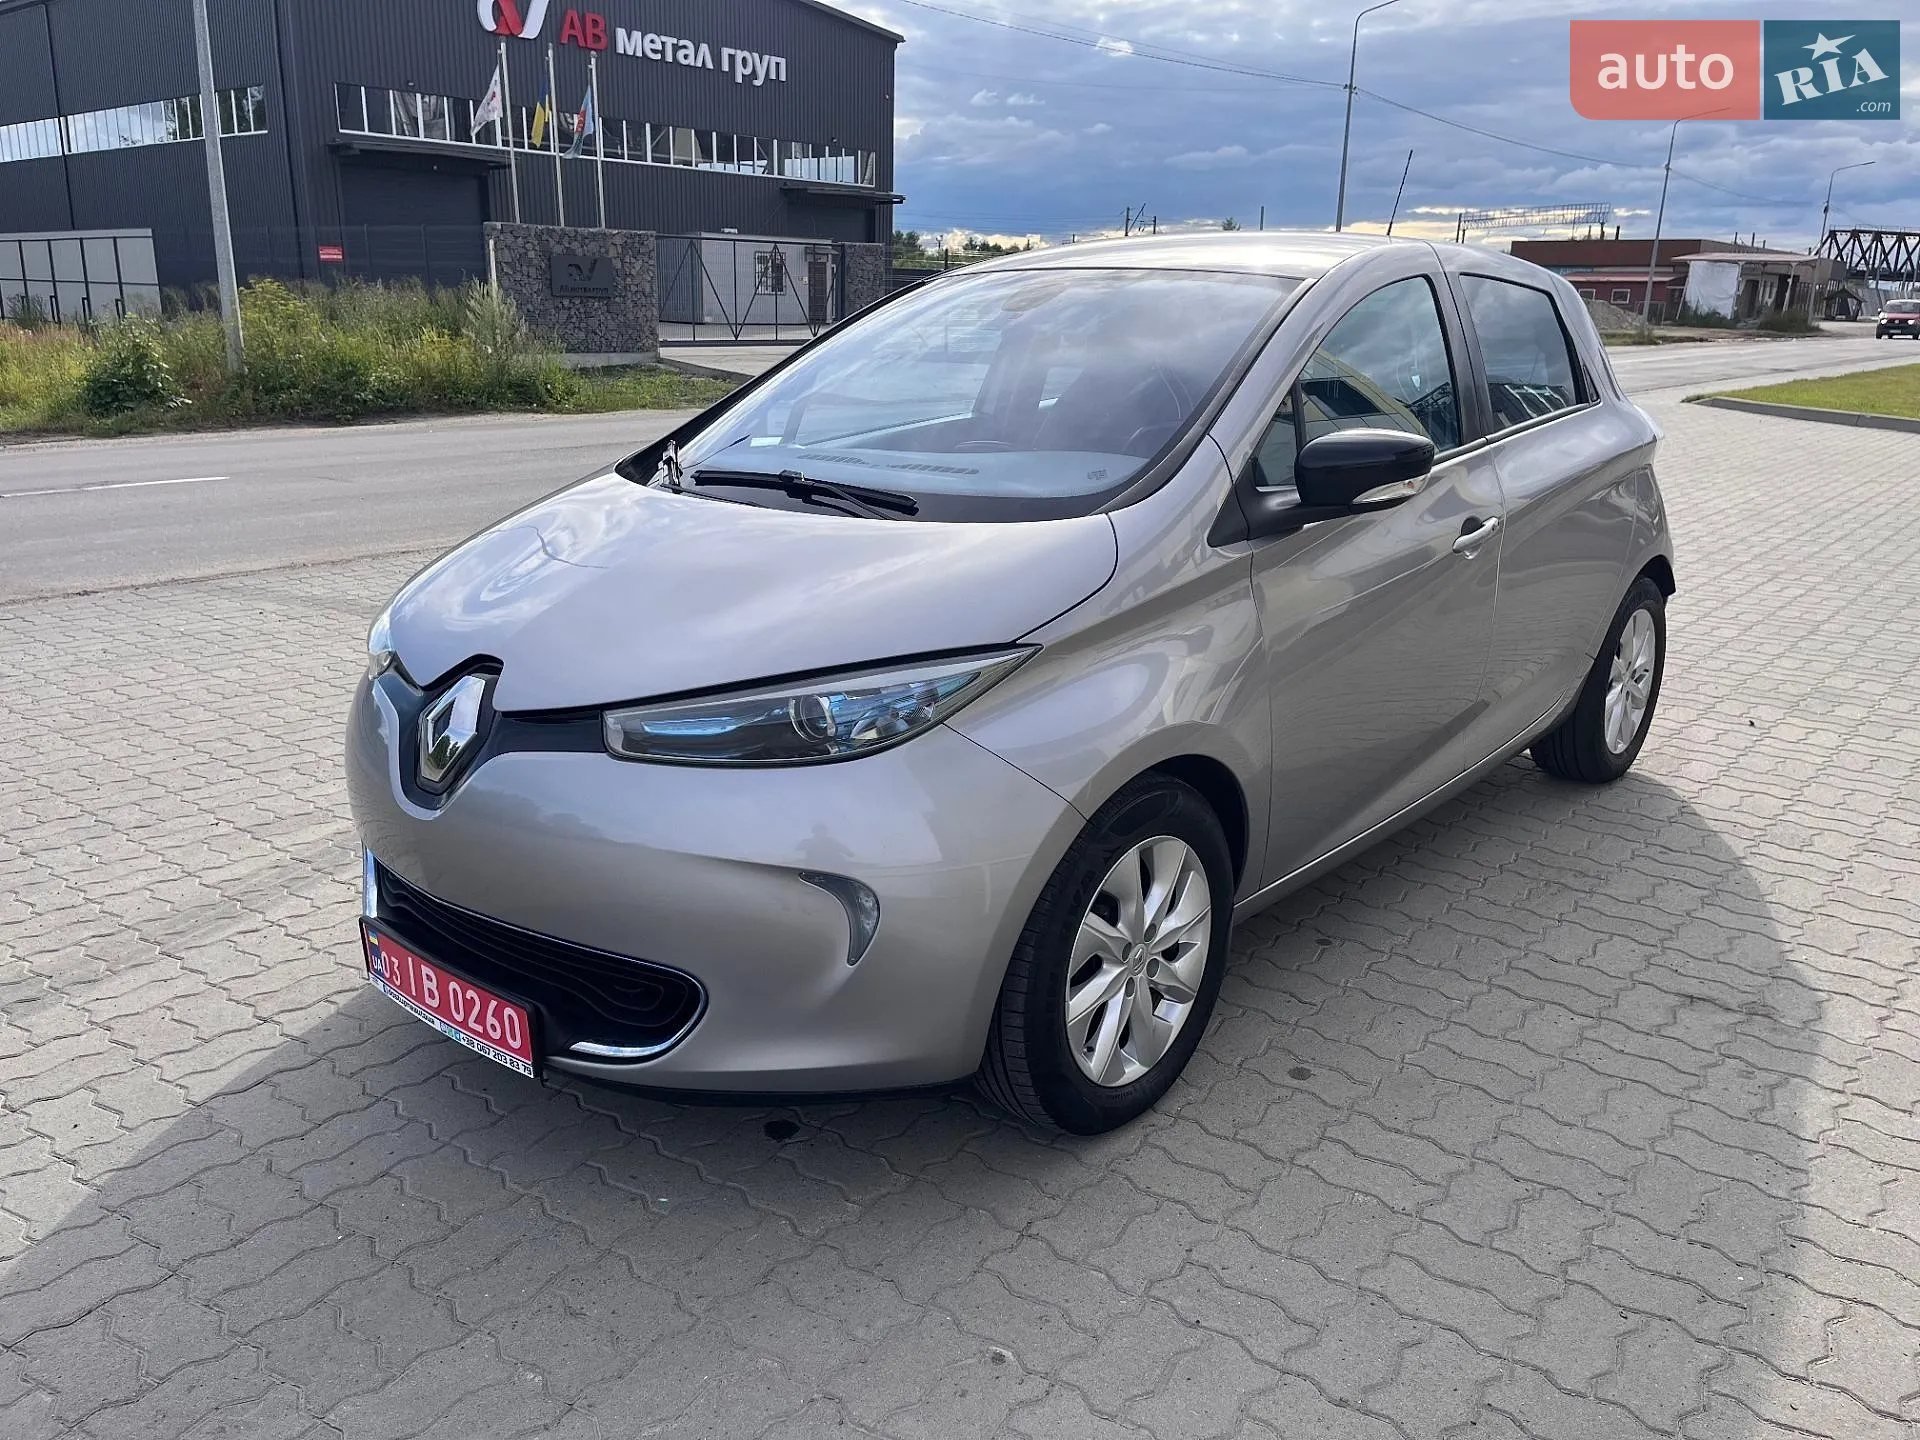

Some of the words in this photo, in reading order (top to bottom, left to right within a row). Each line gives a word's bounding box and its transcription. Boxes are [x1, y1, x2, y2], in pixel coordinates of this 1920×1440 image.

[560, 8, 609, 50] АВ
[615, 27, 714, 70] метал
[720, 47, 787, 86] груп
[372, 955, 383, 973] UA
[381, 951, 401, 986] 03
[448, 981, 522, 1049] 0260
